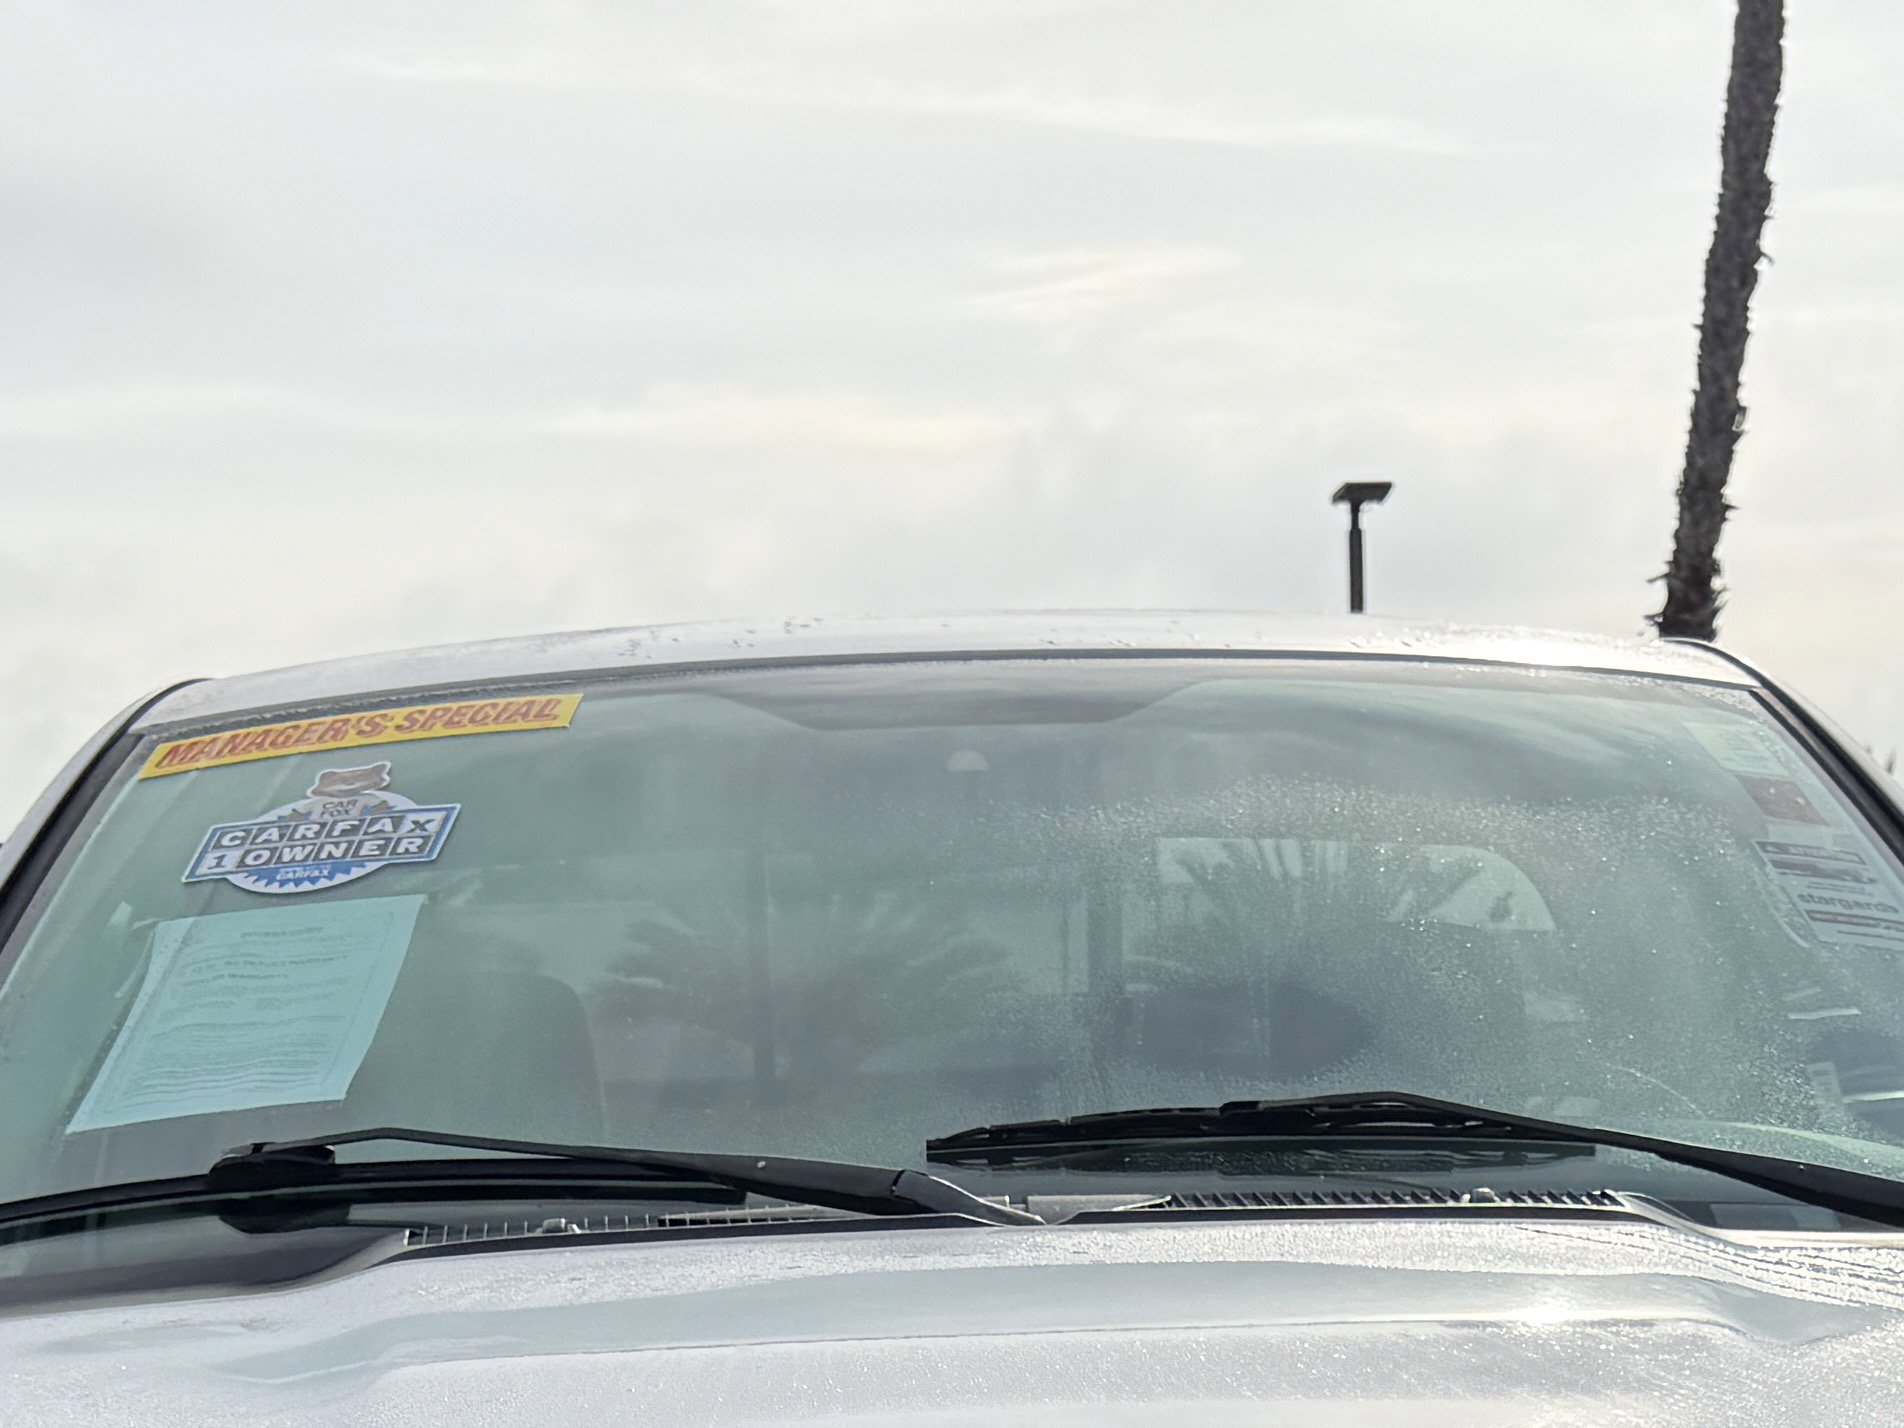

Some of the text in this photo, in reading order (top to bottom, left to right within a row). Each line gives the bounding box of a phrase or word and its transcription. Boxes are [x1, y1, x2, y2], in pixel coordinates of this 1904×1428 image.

[154, 697, 562, 770] MANAGER'S SPECIAL
[220, 816, 436, 847] CARFAX
[206, 837, 426, 871] 1 OWNER
